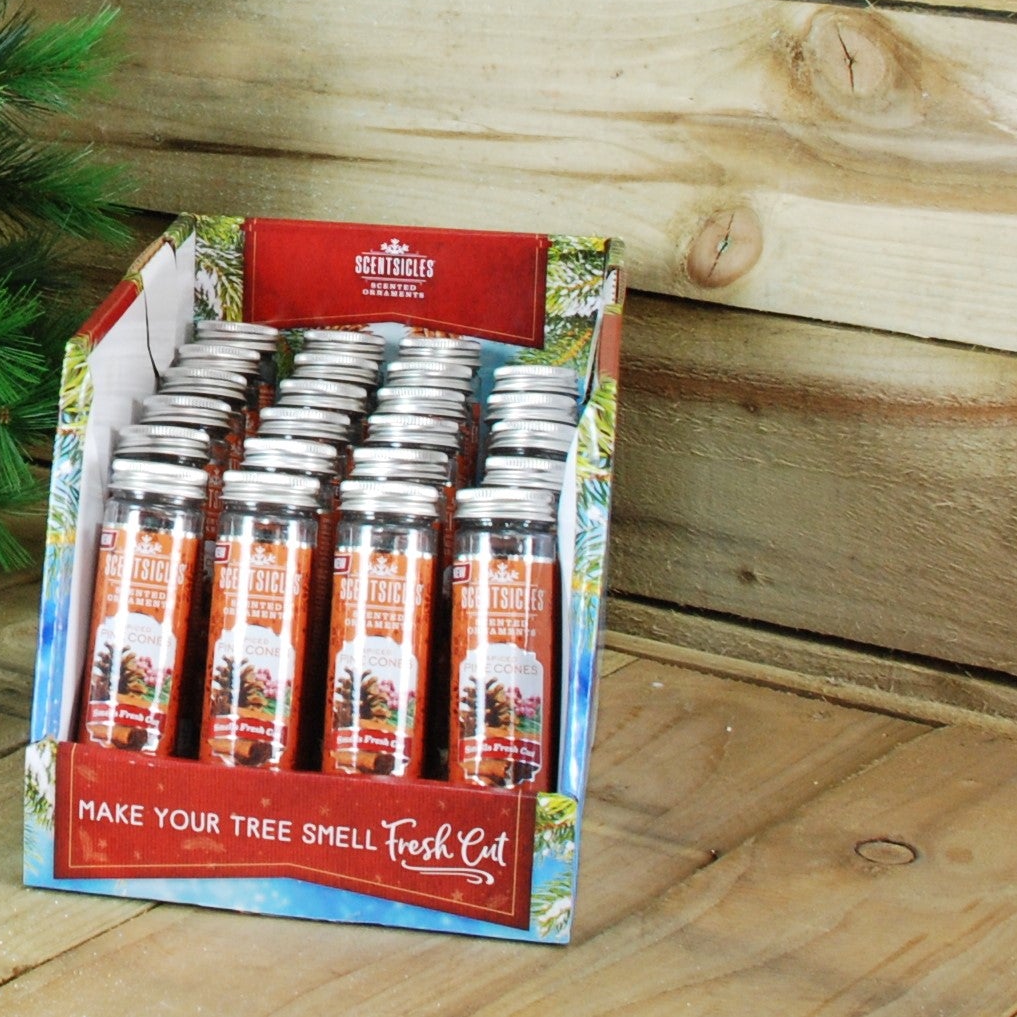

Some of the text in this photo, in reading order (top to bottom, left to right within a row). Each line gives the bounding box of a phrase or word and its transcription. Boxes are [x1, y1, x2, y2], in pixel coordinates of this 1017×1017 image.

[355, 255, 434, 278] SCENTSICLES
[362, 288, 425, 299] ORNAMENTS
[370, 282, 417, 291] SCENTED
[78, 799, 510, 867] MAKE YOUR TREE SMELL Fresh Cut
